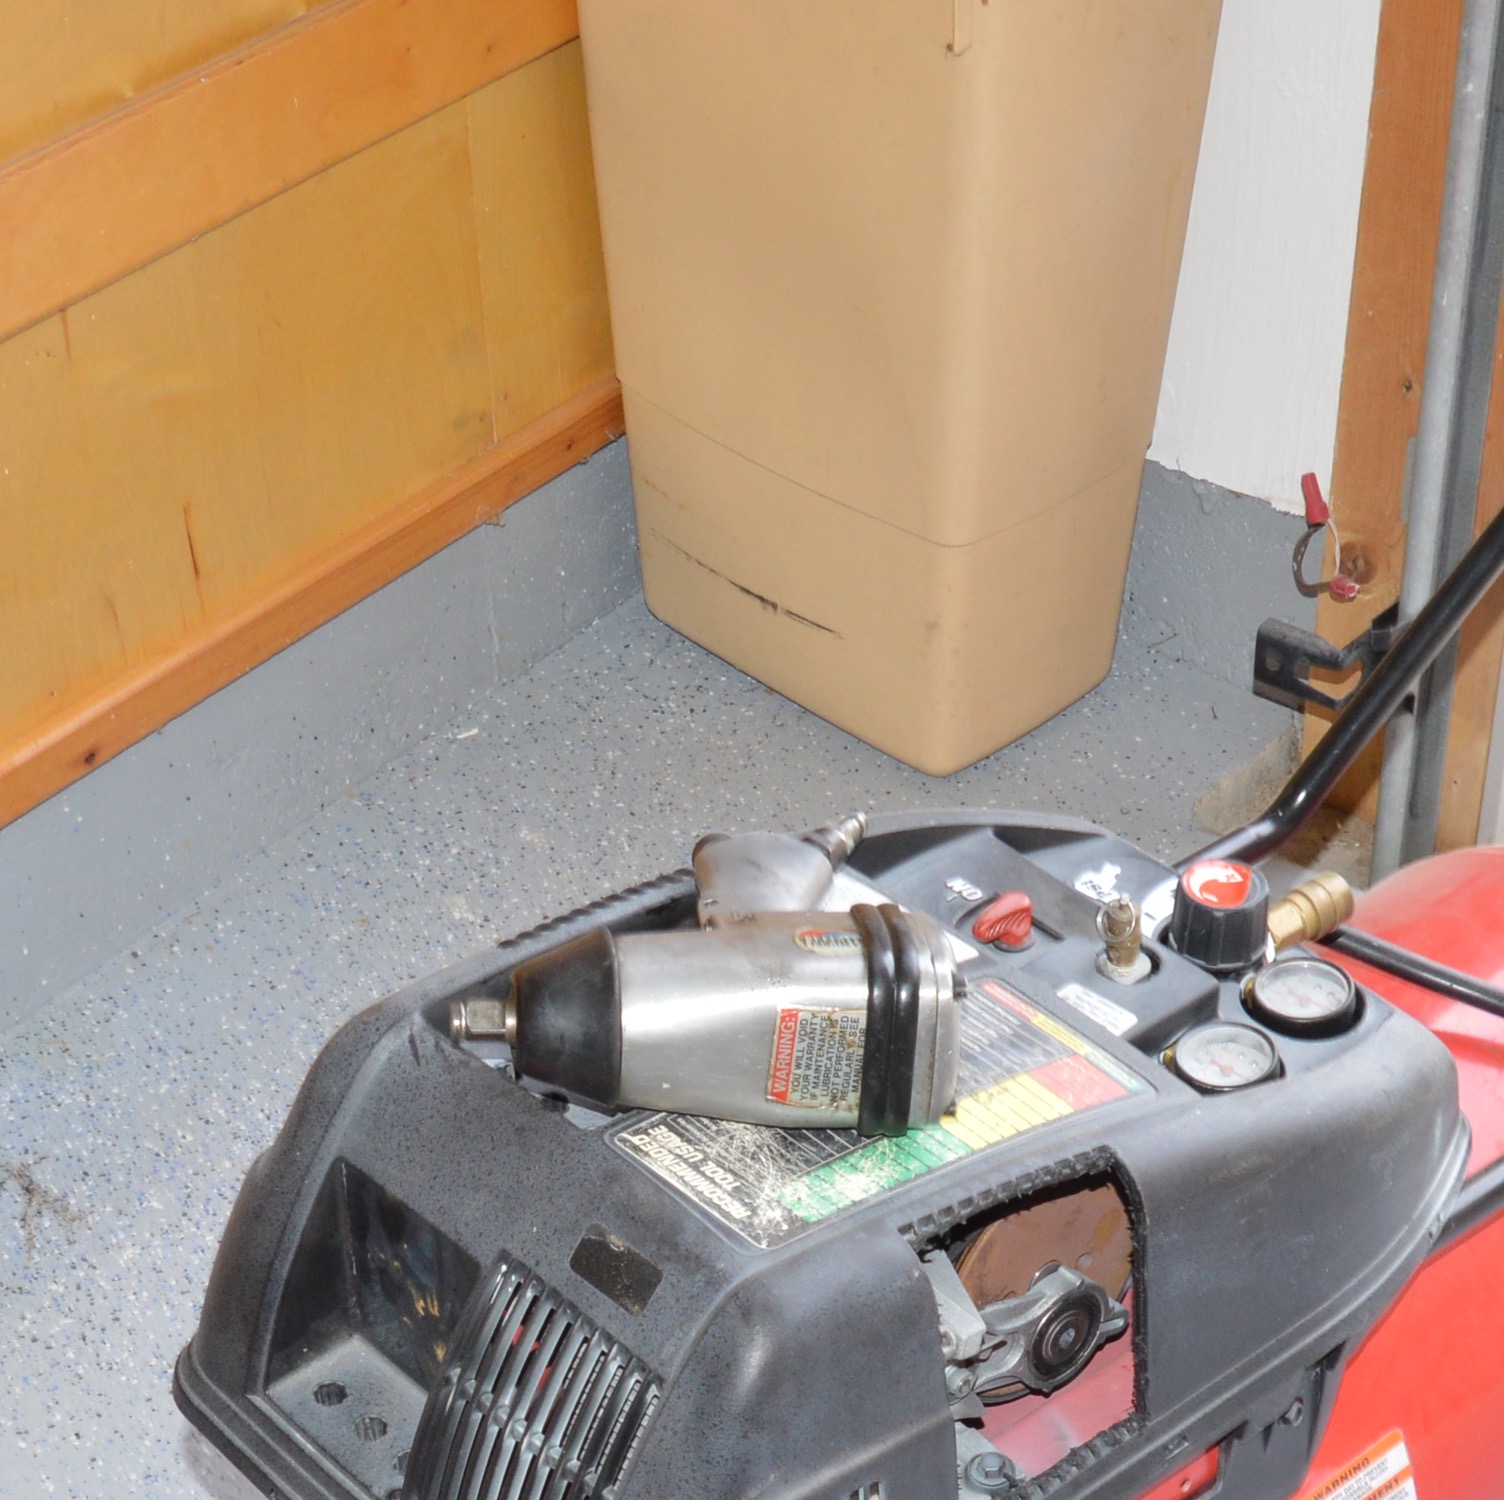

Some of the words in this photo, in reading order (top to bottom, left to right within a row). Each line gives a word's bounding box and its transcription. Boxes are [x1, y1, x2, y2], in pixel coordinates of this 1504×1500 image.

[946, 877, 983, 901] ON
[798, 1019, 808, 1041] VOID
[849, 1018, 859, 1038] SEE
[773, 1017, 795, 1093] WARNING:
[794, 1047, 804, 1070] WILL
[800, 1075, 810, 1101] YOUR
[805, 1014, 819, 1071] WARRANTY
[812, 1015, 828, 1089] MAINTENANCE
[821, 1032, 836, 1097] LUBRICATION
[834, 1016, 849, 1079] PERFORMED
[791, 1071, 801, 1094] YOU
[830, 1081, 840, 1102] NOT
[851, 1055, 864, 1093] MANUAL
[810, 1092, 818, 1100] IF
[648, 1125, 704, 1163] USAGE
[632, 1134, 751, 1219] RECOMMENDED
[700, 1161, 742, 1191] TOOL
[1314, 1457, 1371, 1500] WARNING
